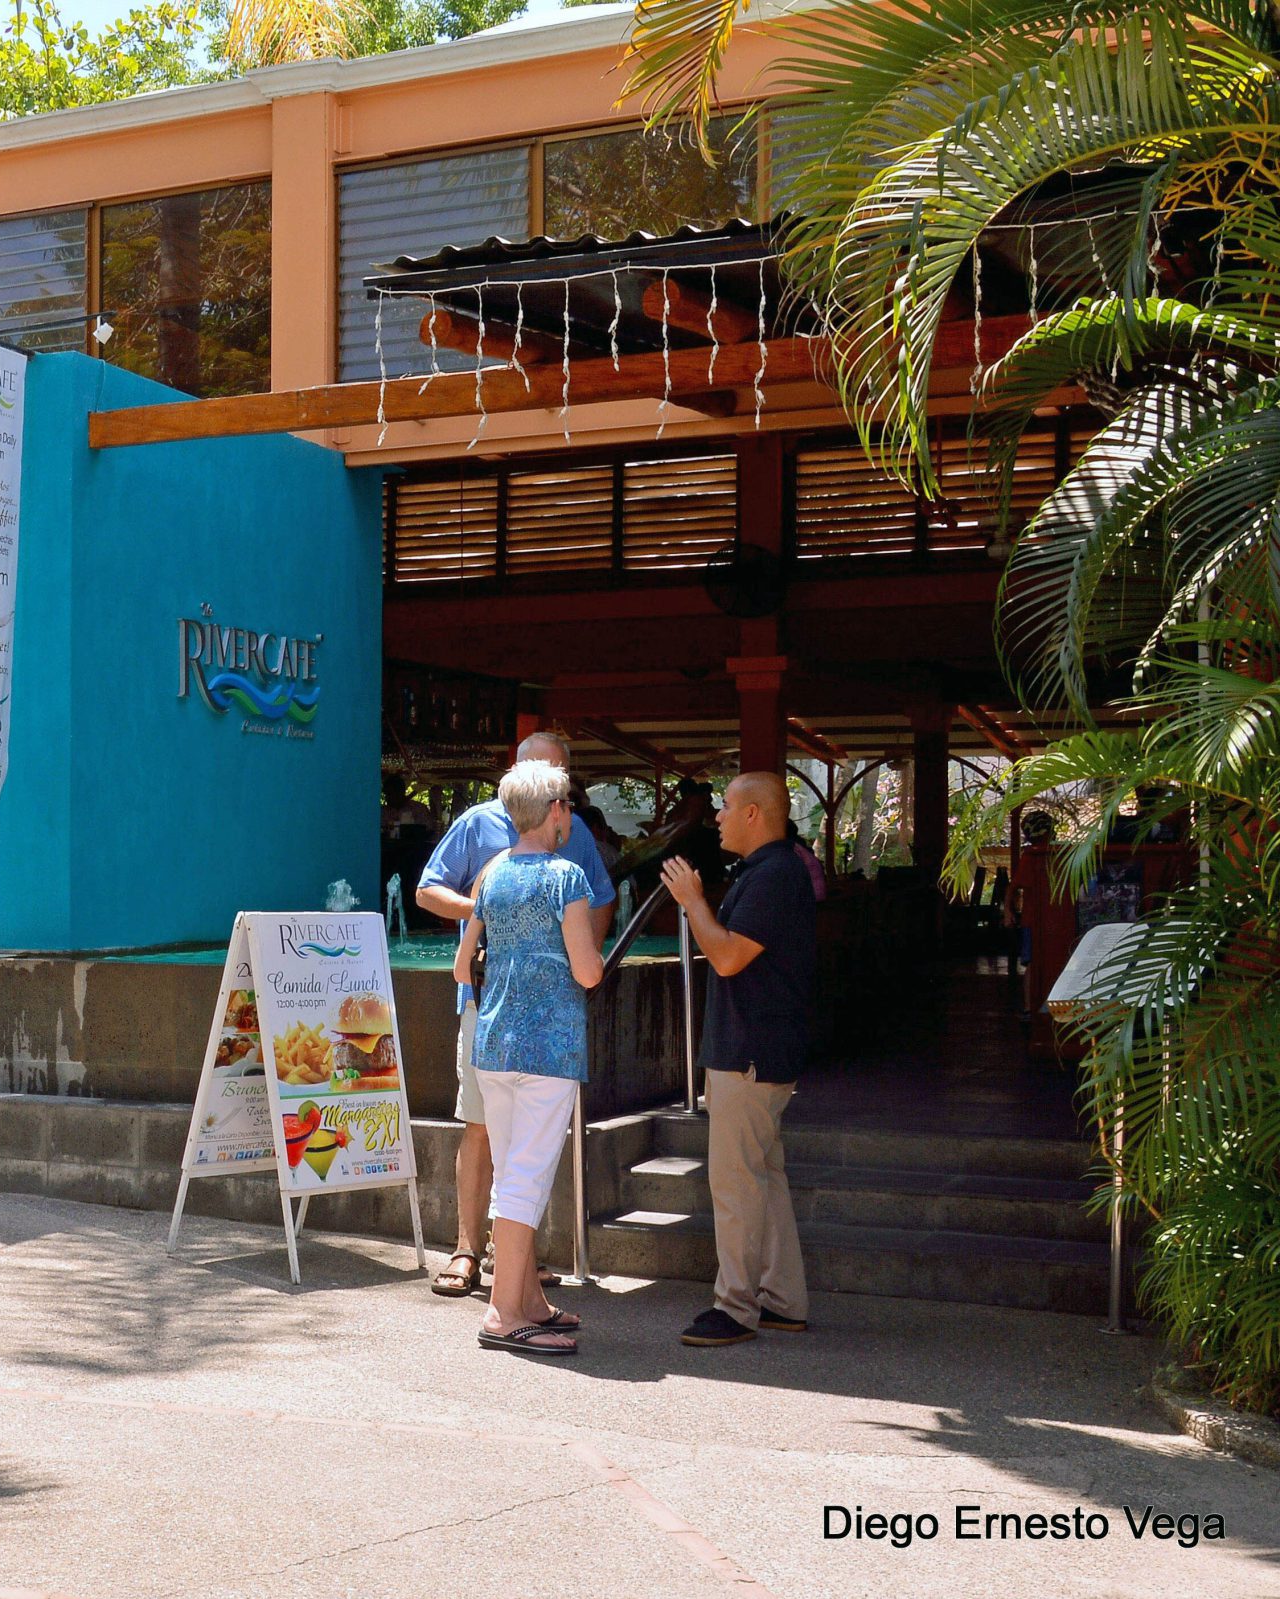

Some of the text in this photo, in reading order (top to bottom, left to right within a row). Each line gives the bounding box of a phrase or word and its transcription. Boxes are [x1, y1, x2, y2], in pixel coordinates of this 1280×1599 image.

[176, 617, 318, 715] RIVERCAFE
[279, 924, 361, 959] RIVERCAFE
[267, 971, 322, 995] Comida
[329, 969, 380, 993] Lunch
